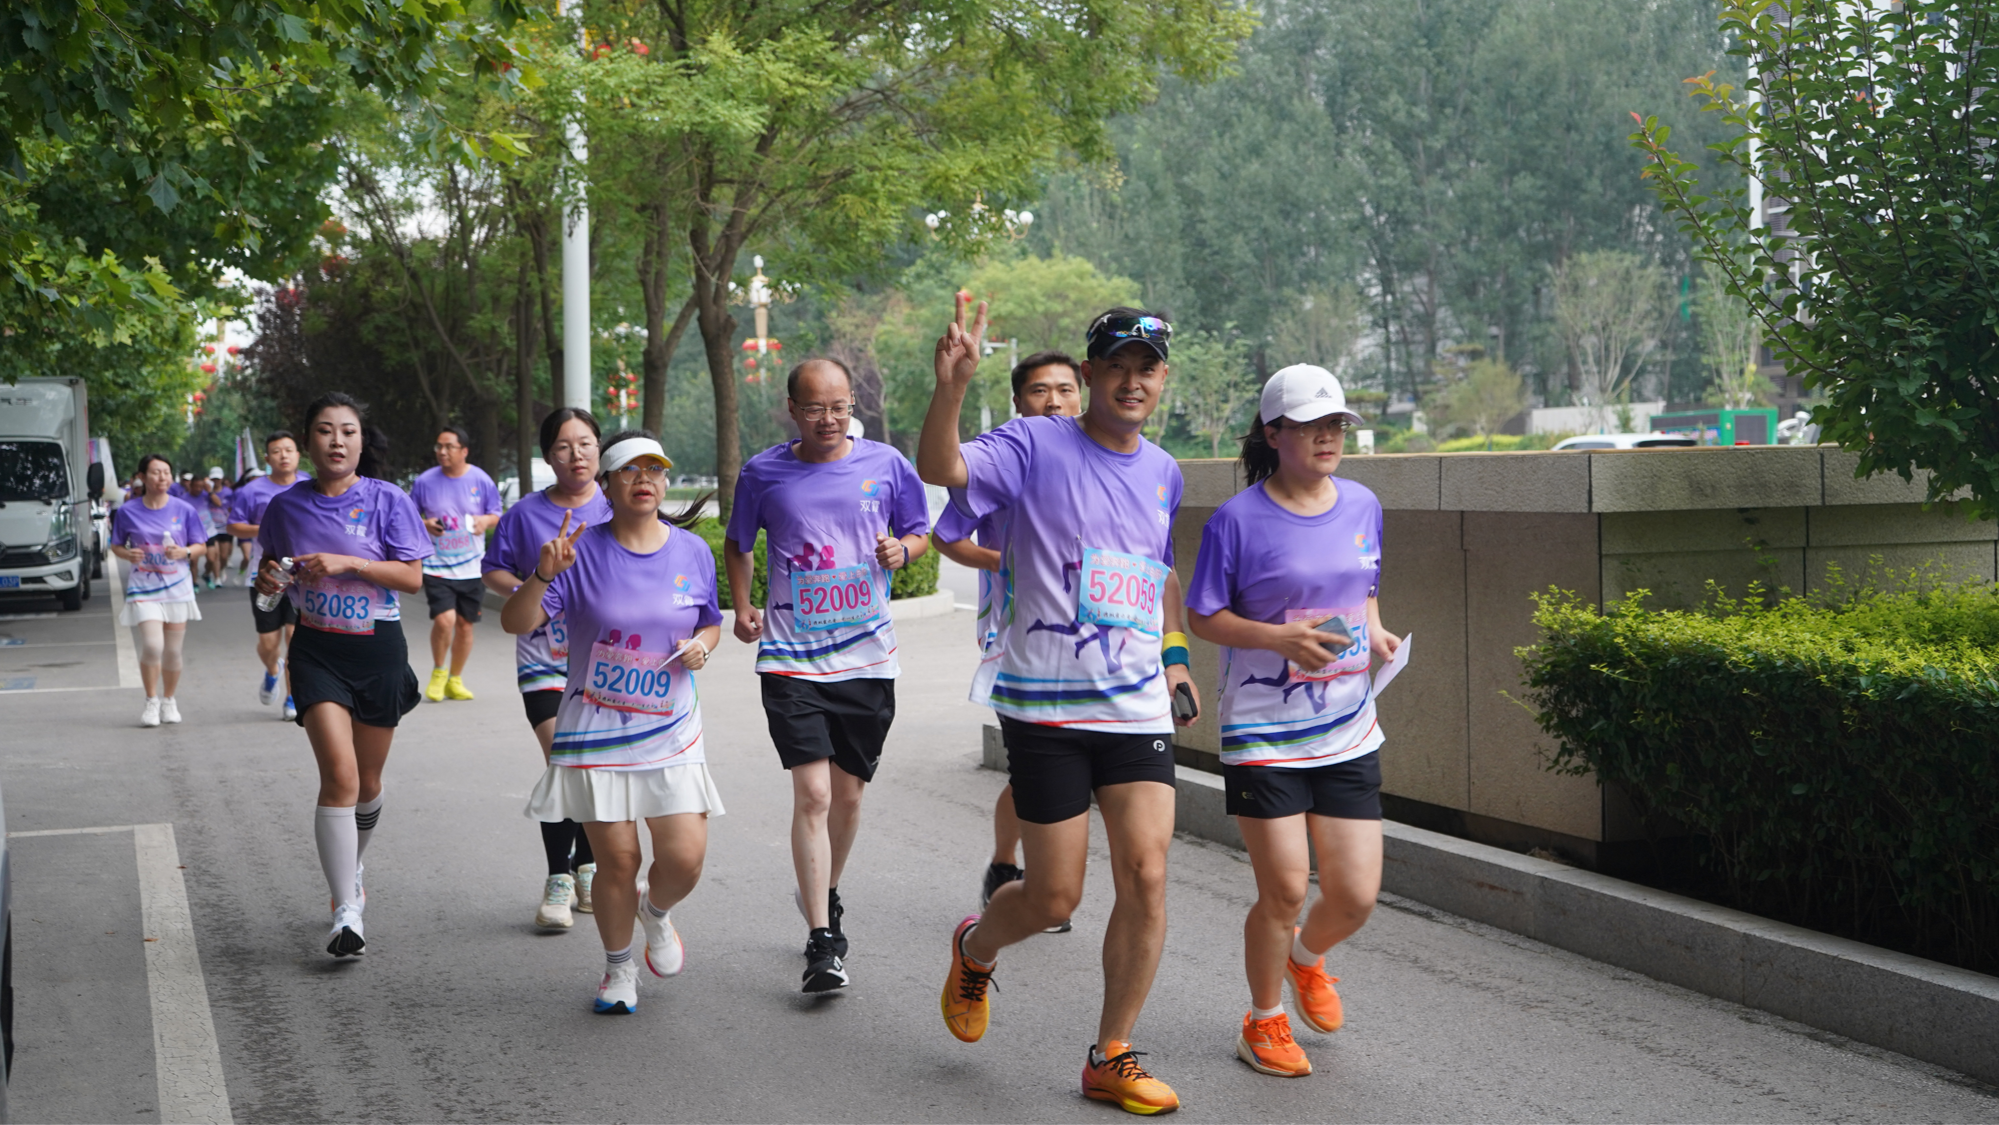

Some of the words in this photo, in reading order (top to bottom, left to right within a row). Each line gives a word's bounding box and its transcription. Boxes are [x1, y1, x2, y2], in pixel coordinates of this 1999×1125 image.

[305, 590, 370, 620] 52083
[798, 580, 872, 615] 52009
[1088, 569, 1156, 615] 52059
[592, 661, 671, 698] 52009
